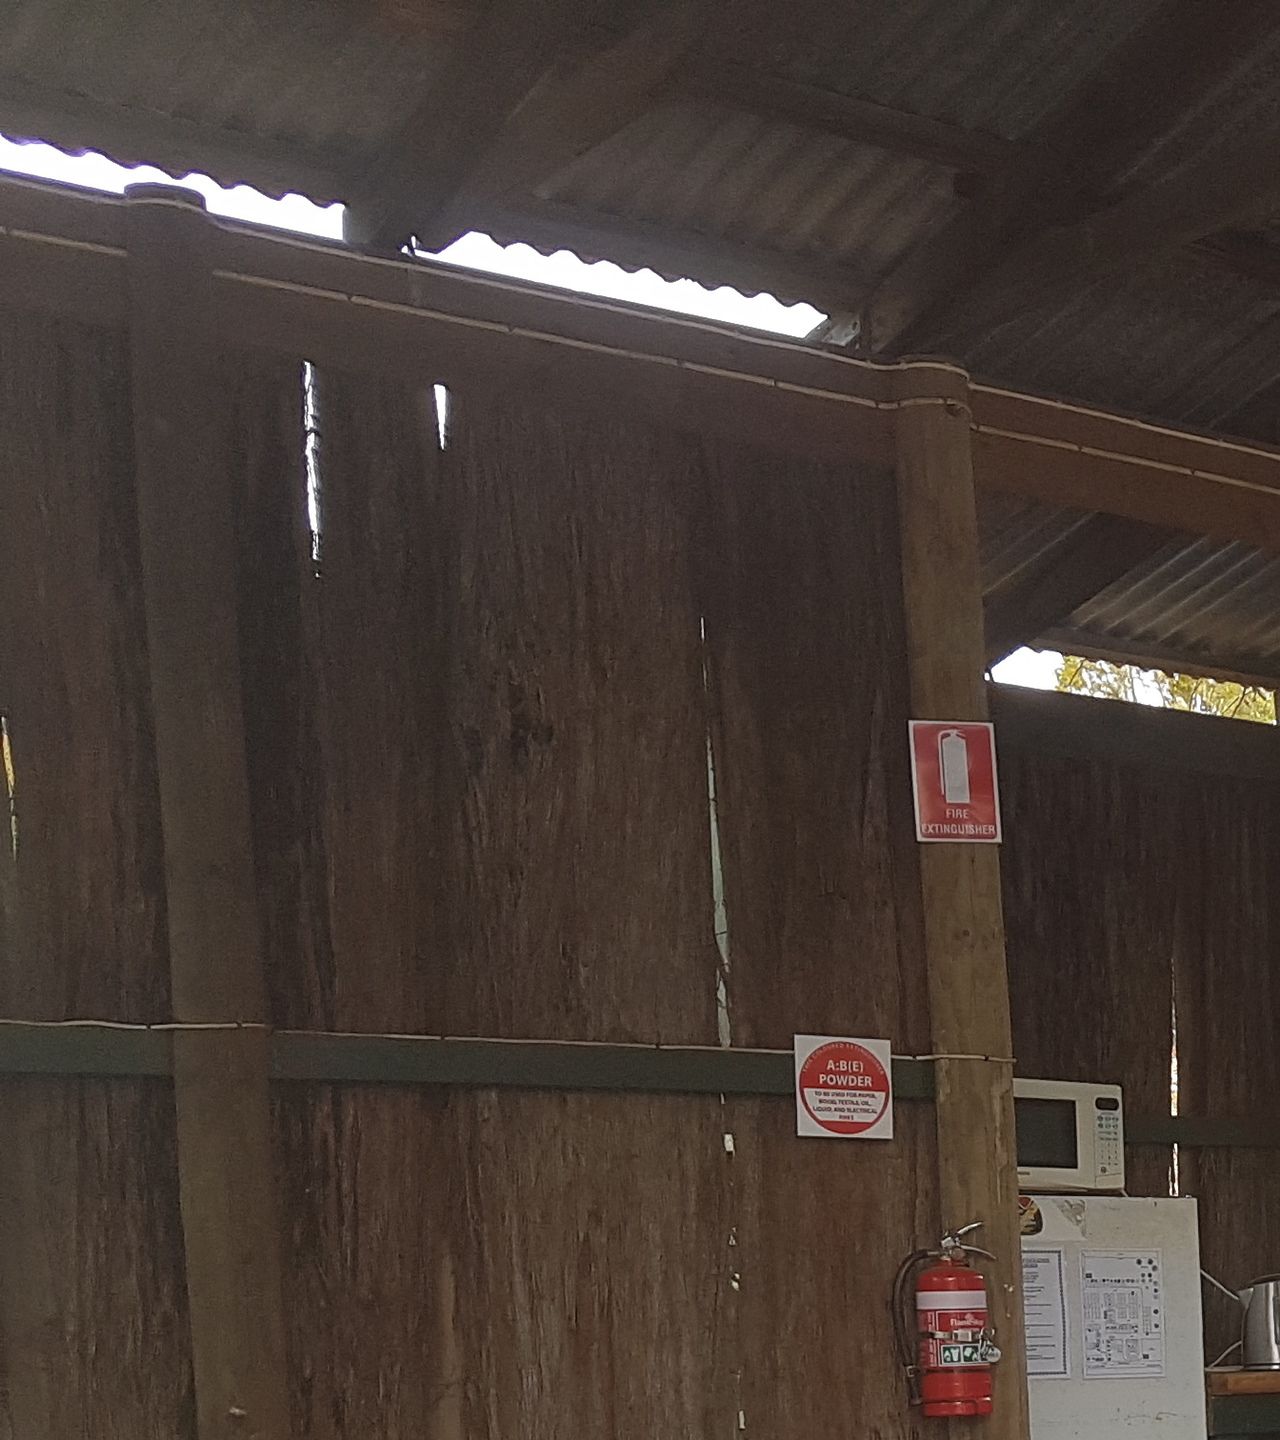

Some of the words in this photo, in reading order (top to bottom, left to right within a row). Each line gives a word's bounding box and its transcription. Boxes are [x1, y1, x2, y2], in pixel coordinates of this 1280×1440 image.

[946, 809, 970, 819] FIRE
[921, 824, 996, 835] EXTINGUISHER
[826, 1060, 864, 1073] A:B(E)
[819, 1074, 873, 1088] POWDER
